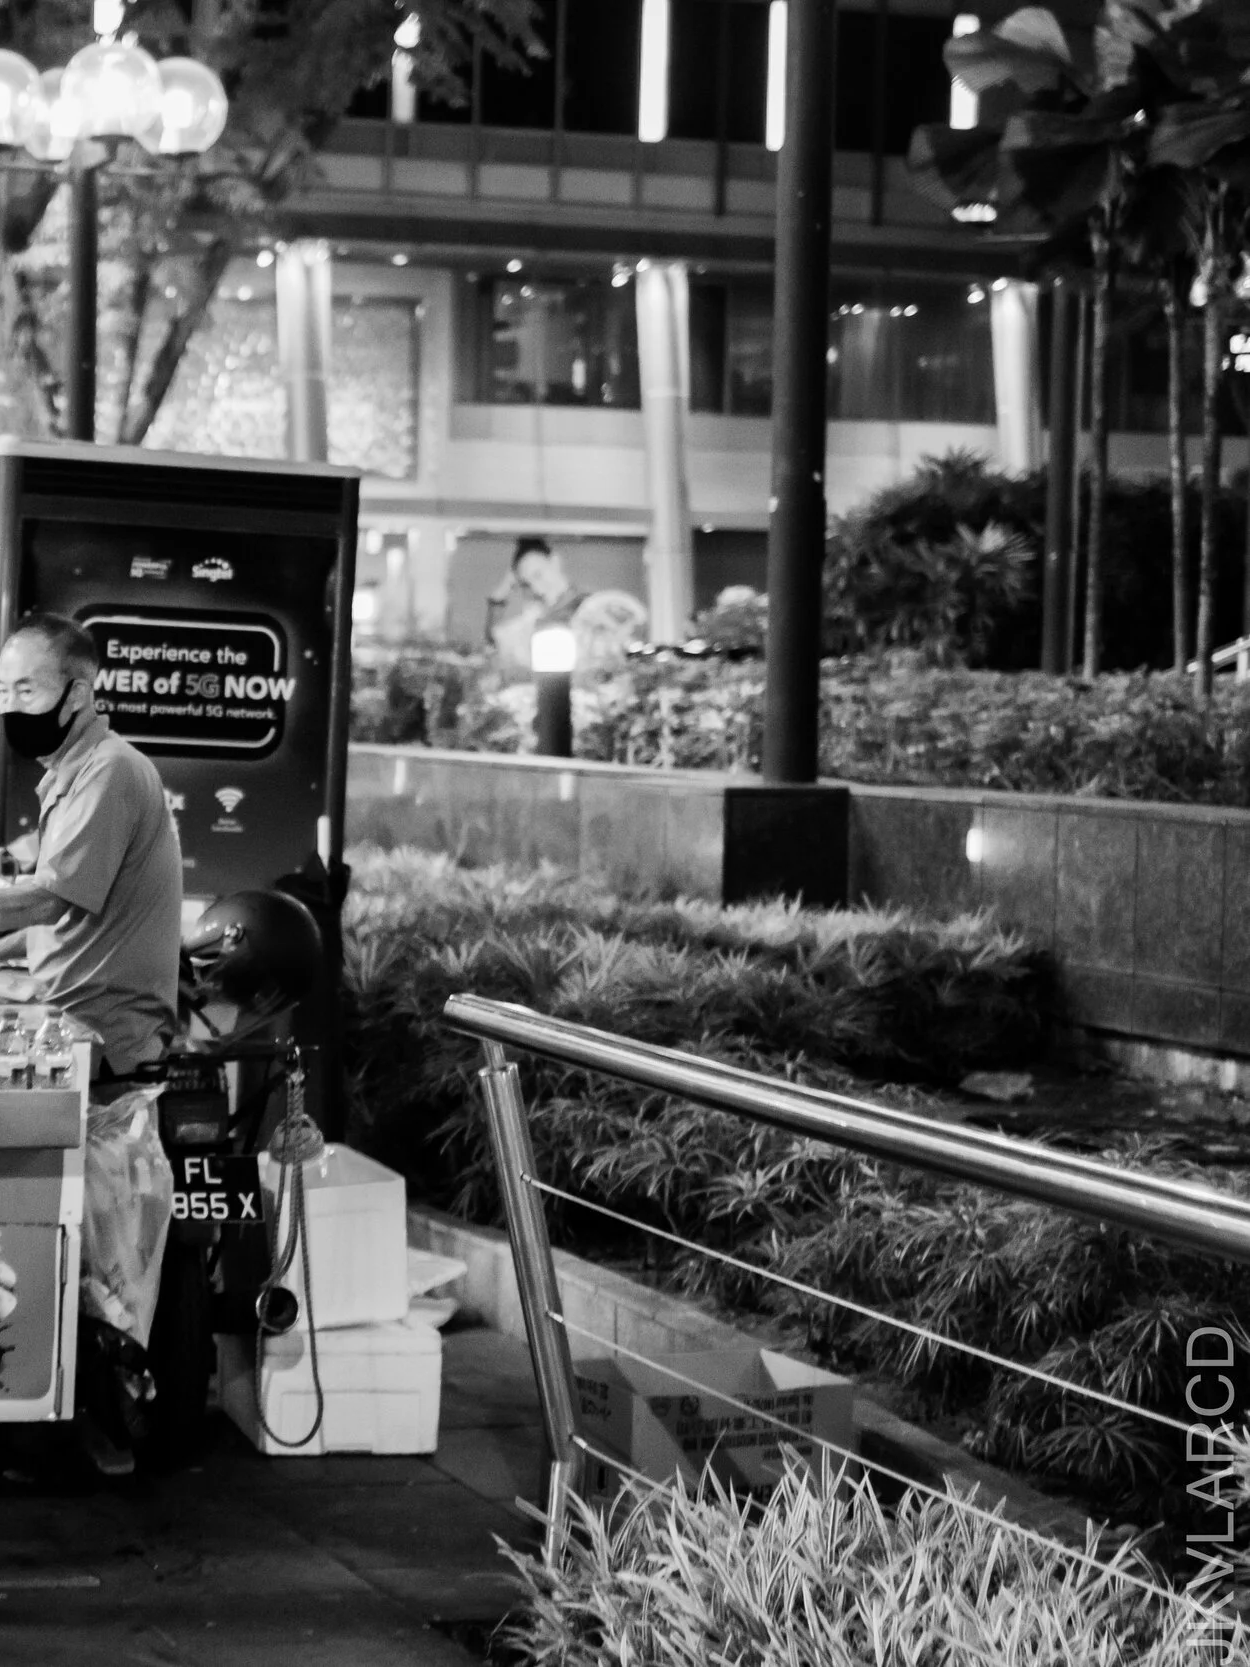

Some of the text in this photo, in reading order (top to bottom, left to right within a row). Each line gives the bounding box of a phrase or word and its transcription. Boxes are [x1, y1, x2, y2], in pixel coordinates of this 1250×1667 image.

[106, 639, 248, 666] Experience the
[93, 668, 297, 701] WER of 5G NOW
[116, 702, 148, 714] most
[149, 702, 203, 718] powerful
[205, 704, 224, 718] 5G
[183, 1157, 223, 1184] FL
[238, 1192, 257, 1219] X
